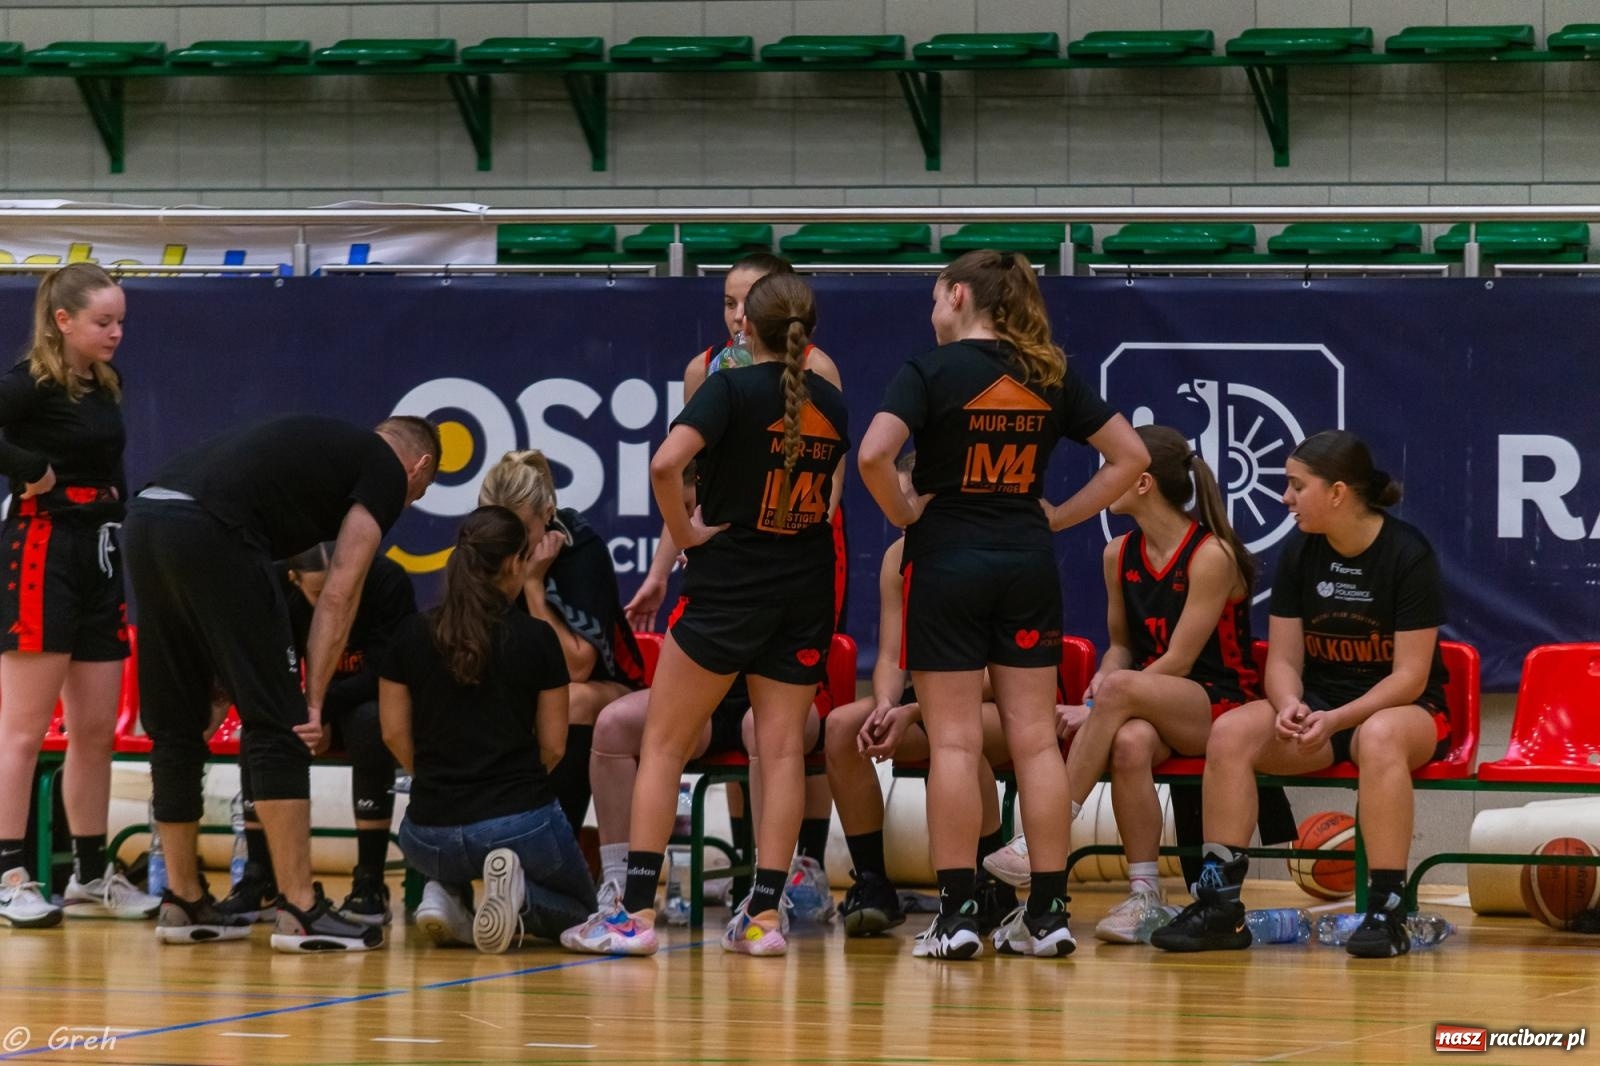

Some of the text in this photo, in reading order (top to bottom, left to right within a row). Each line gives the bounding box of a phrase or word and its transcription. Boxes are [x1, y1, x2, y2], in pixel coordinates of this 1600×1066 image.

[969, 414, 1045, 432] MUR-BET
[388, 377, 685, 518] OSi
[770, 437, 836, 461] MR-BET
[1304, 633, 1394, 663] OLKOWIC
